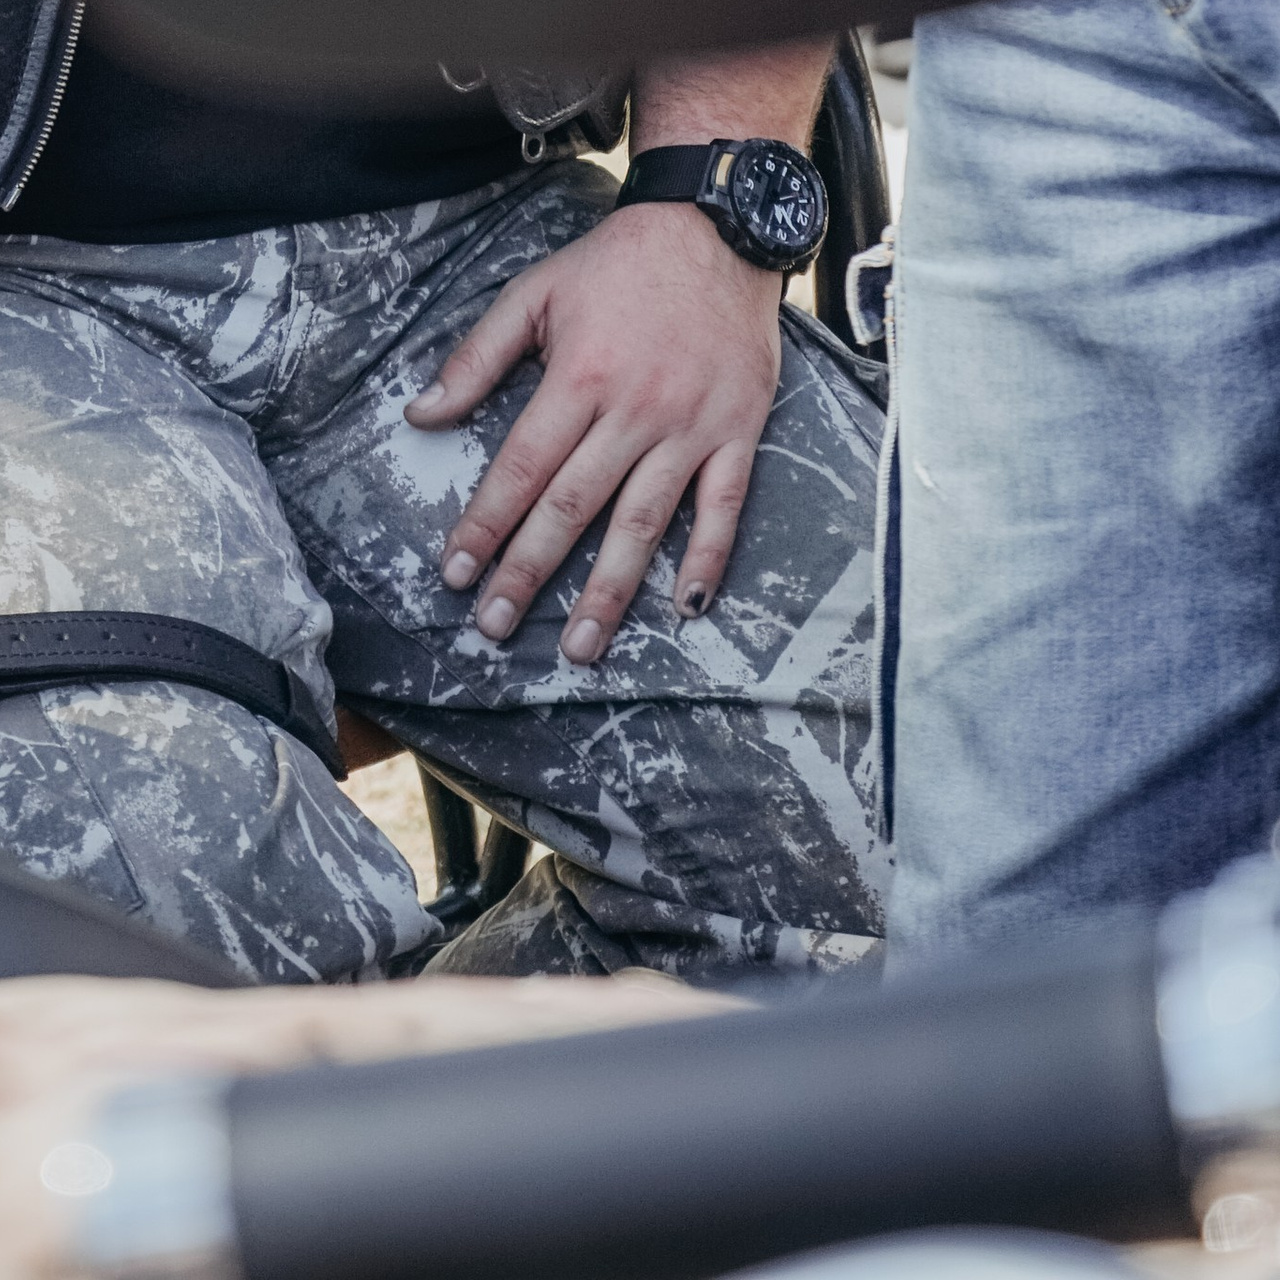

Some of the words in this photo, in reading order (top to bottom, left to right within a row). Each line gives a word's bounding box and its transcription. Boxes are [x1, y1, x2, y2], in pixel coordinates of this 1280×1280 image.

[765, 159, 776, 172] 8
[790, 177, 801, 191] 10
[797, 209, 809, 226] 12
